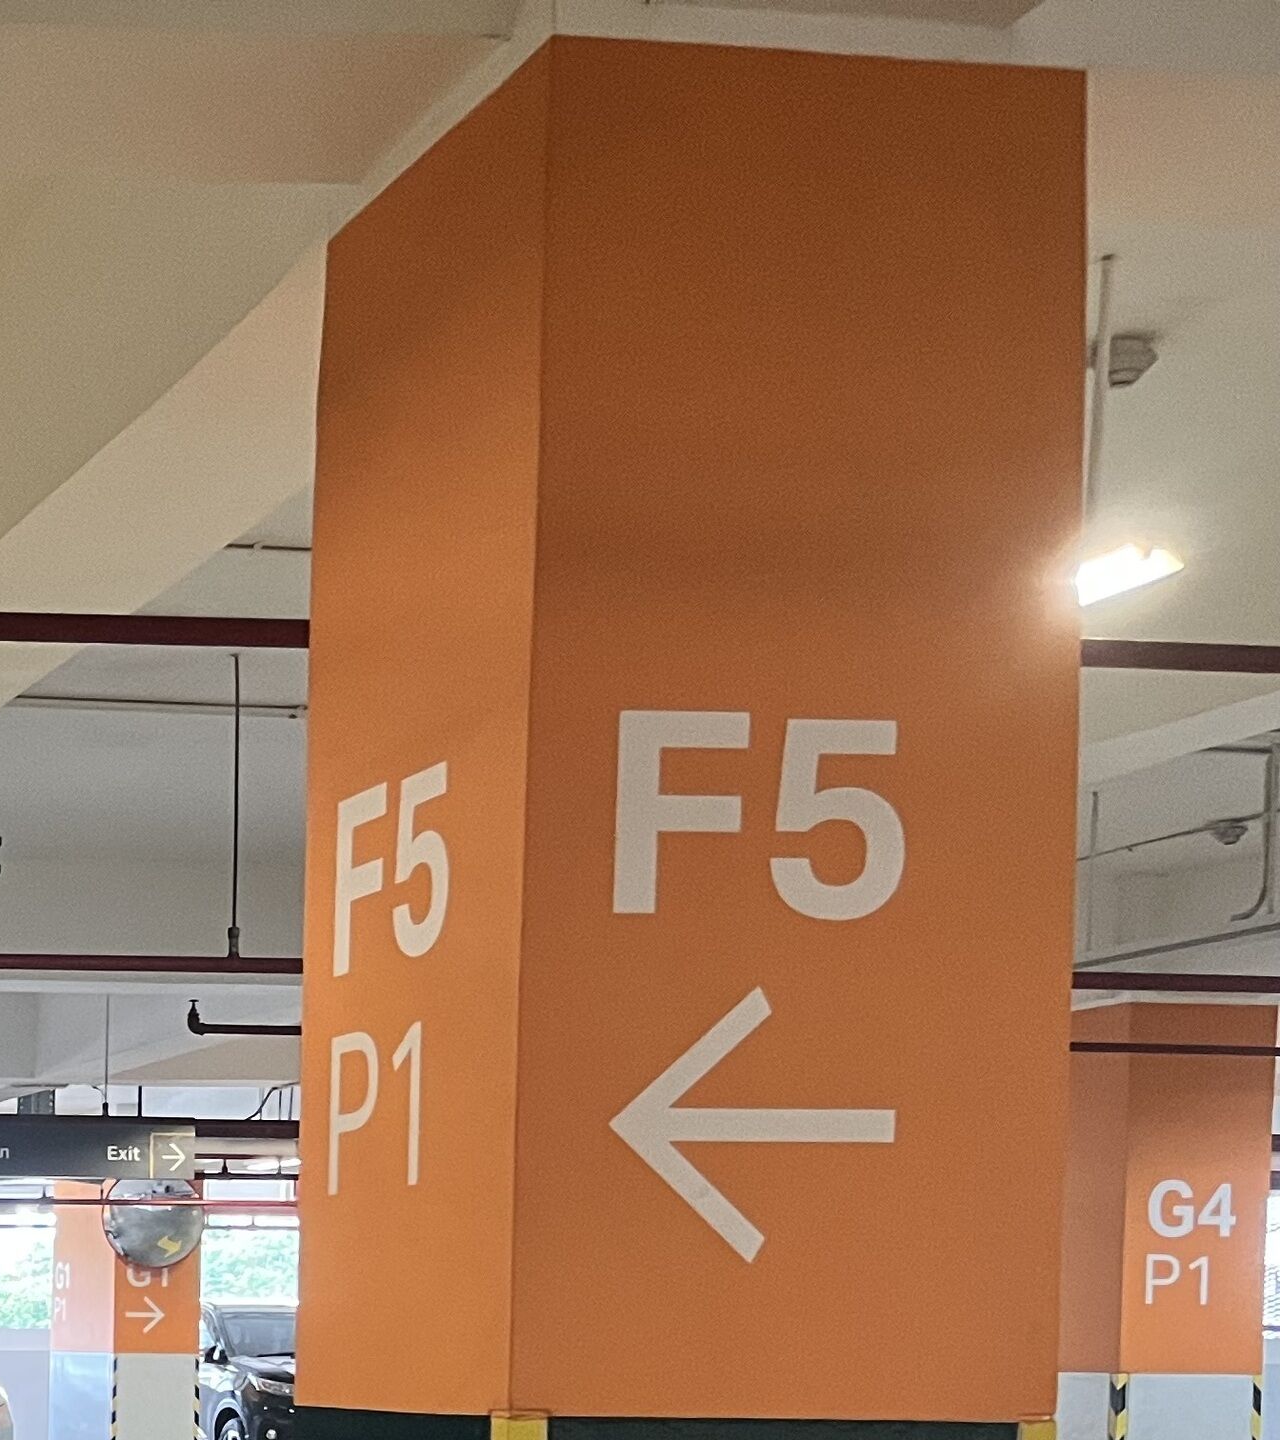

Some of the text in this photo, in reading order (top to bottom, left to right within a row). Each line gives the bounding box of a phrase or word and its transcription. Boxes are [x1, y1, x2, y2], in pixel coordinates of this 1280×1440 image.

[613, 710, 905, 921] F5
[333, 761, 449, 977] F5
[328, 1021, 422, 1196] P1
[107, 1145, 140, 1161] Exit
[1147, 1179, 1236, 1237] G4
[55, 1262, 70, 1289] G1
[1144, 1253, 1209, 1305] P1
